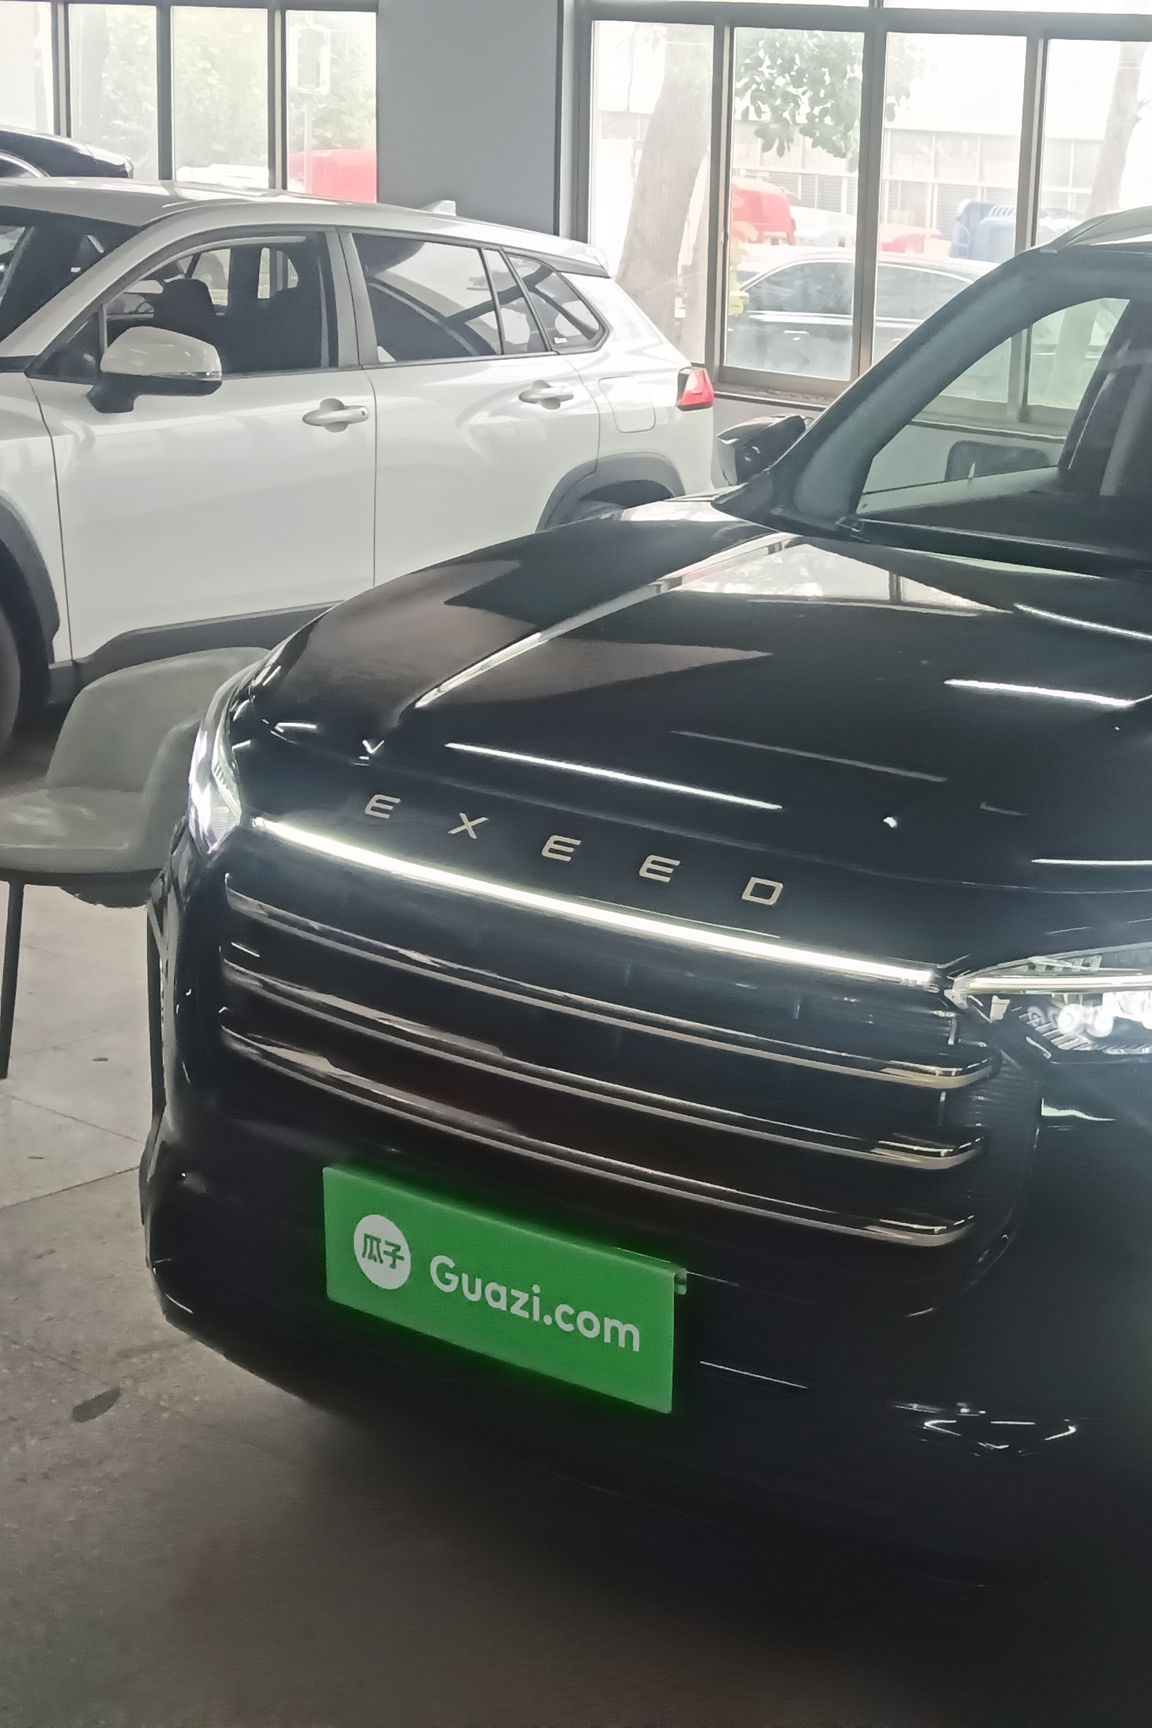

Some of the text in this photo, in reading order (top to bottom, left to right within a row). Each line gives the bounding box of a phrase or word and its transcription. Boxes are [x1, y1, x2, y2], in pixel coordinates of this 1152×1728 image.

[364, 794, 783, 905] EXEED
[361, 1232, 640, 1352] 瓜子 Guazi.com
